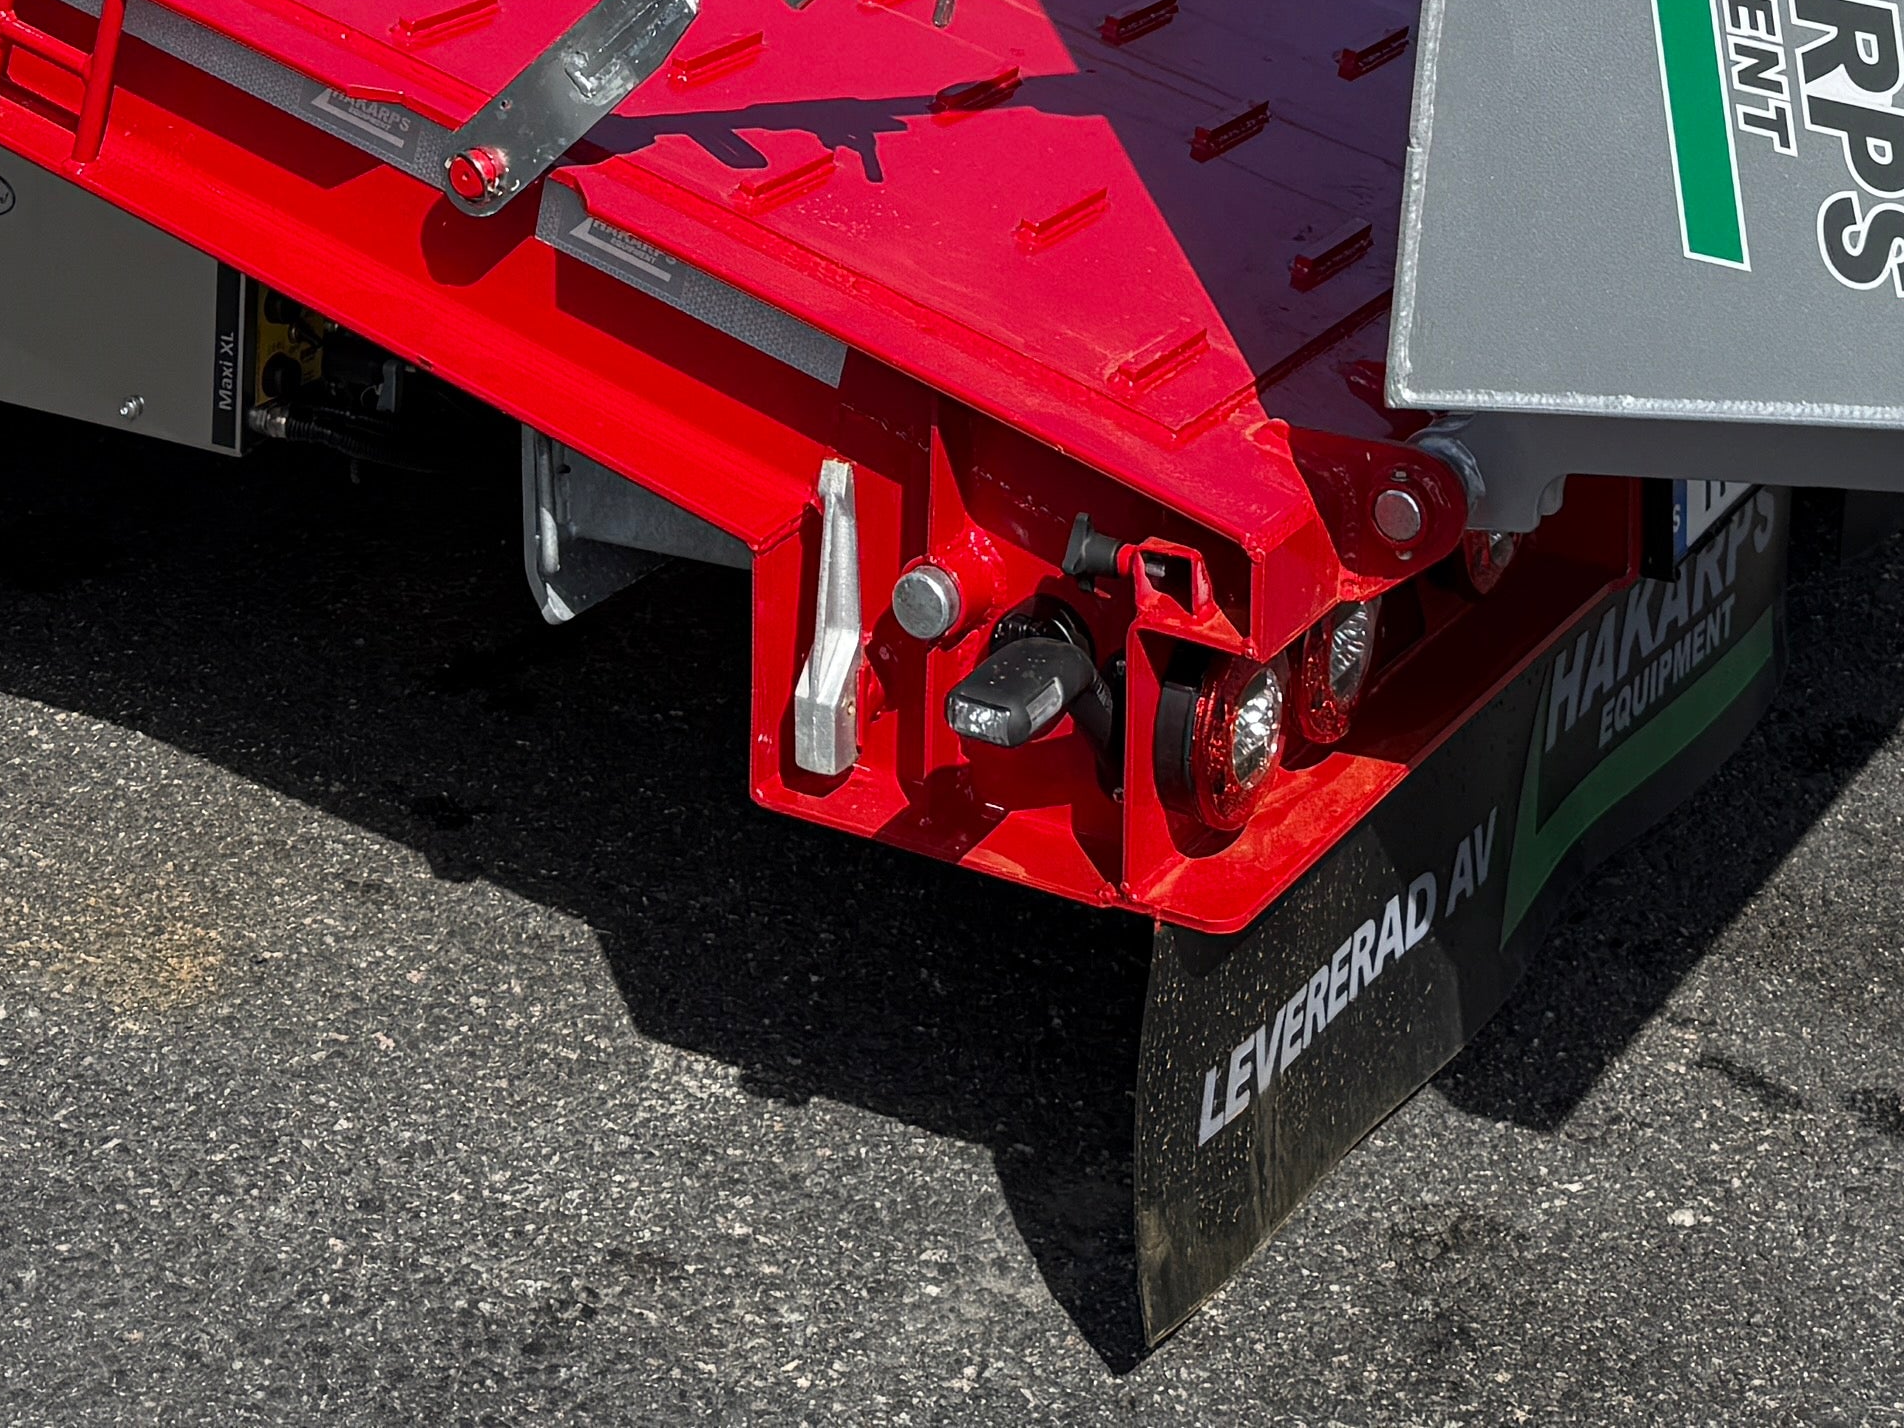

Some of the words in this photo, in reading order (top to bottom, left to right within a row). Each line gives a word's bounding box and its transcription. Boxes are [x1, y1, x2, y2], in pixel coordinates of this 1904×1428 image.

[218, 360, 234, 411] Maxi
[220, 331, 235, 356] XL
[1598, 592, 1737, 750] EQUIPMENT
[1198, 871, 1438, 1148] LEVERERAD
[1445, 805, 1498, 919] AV
